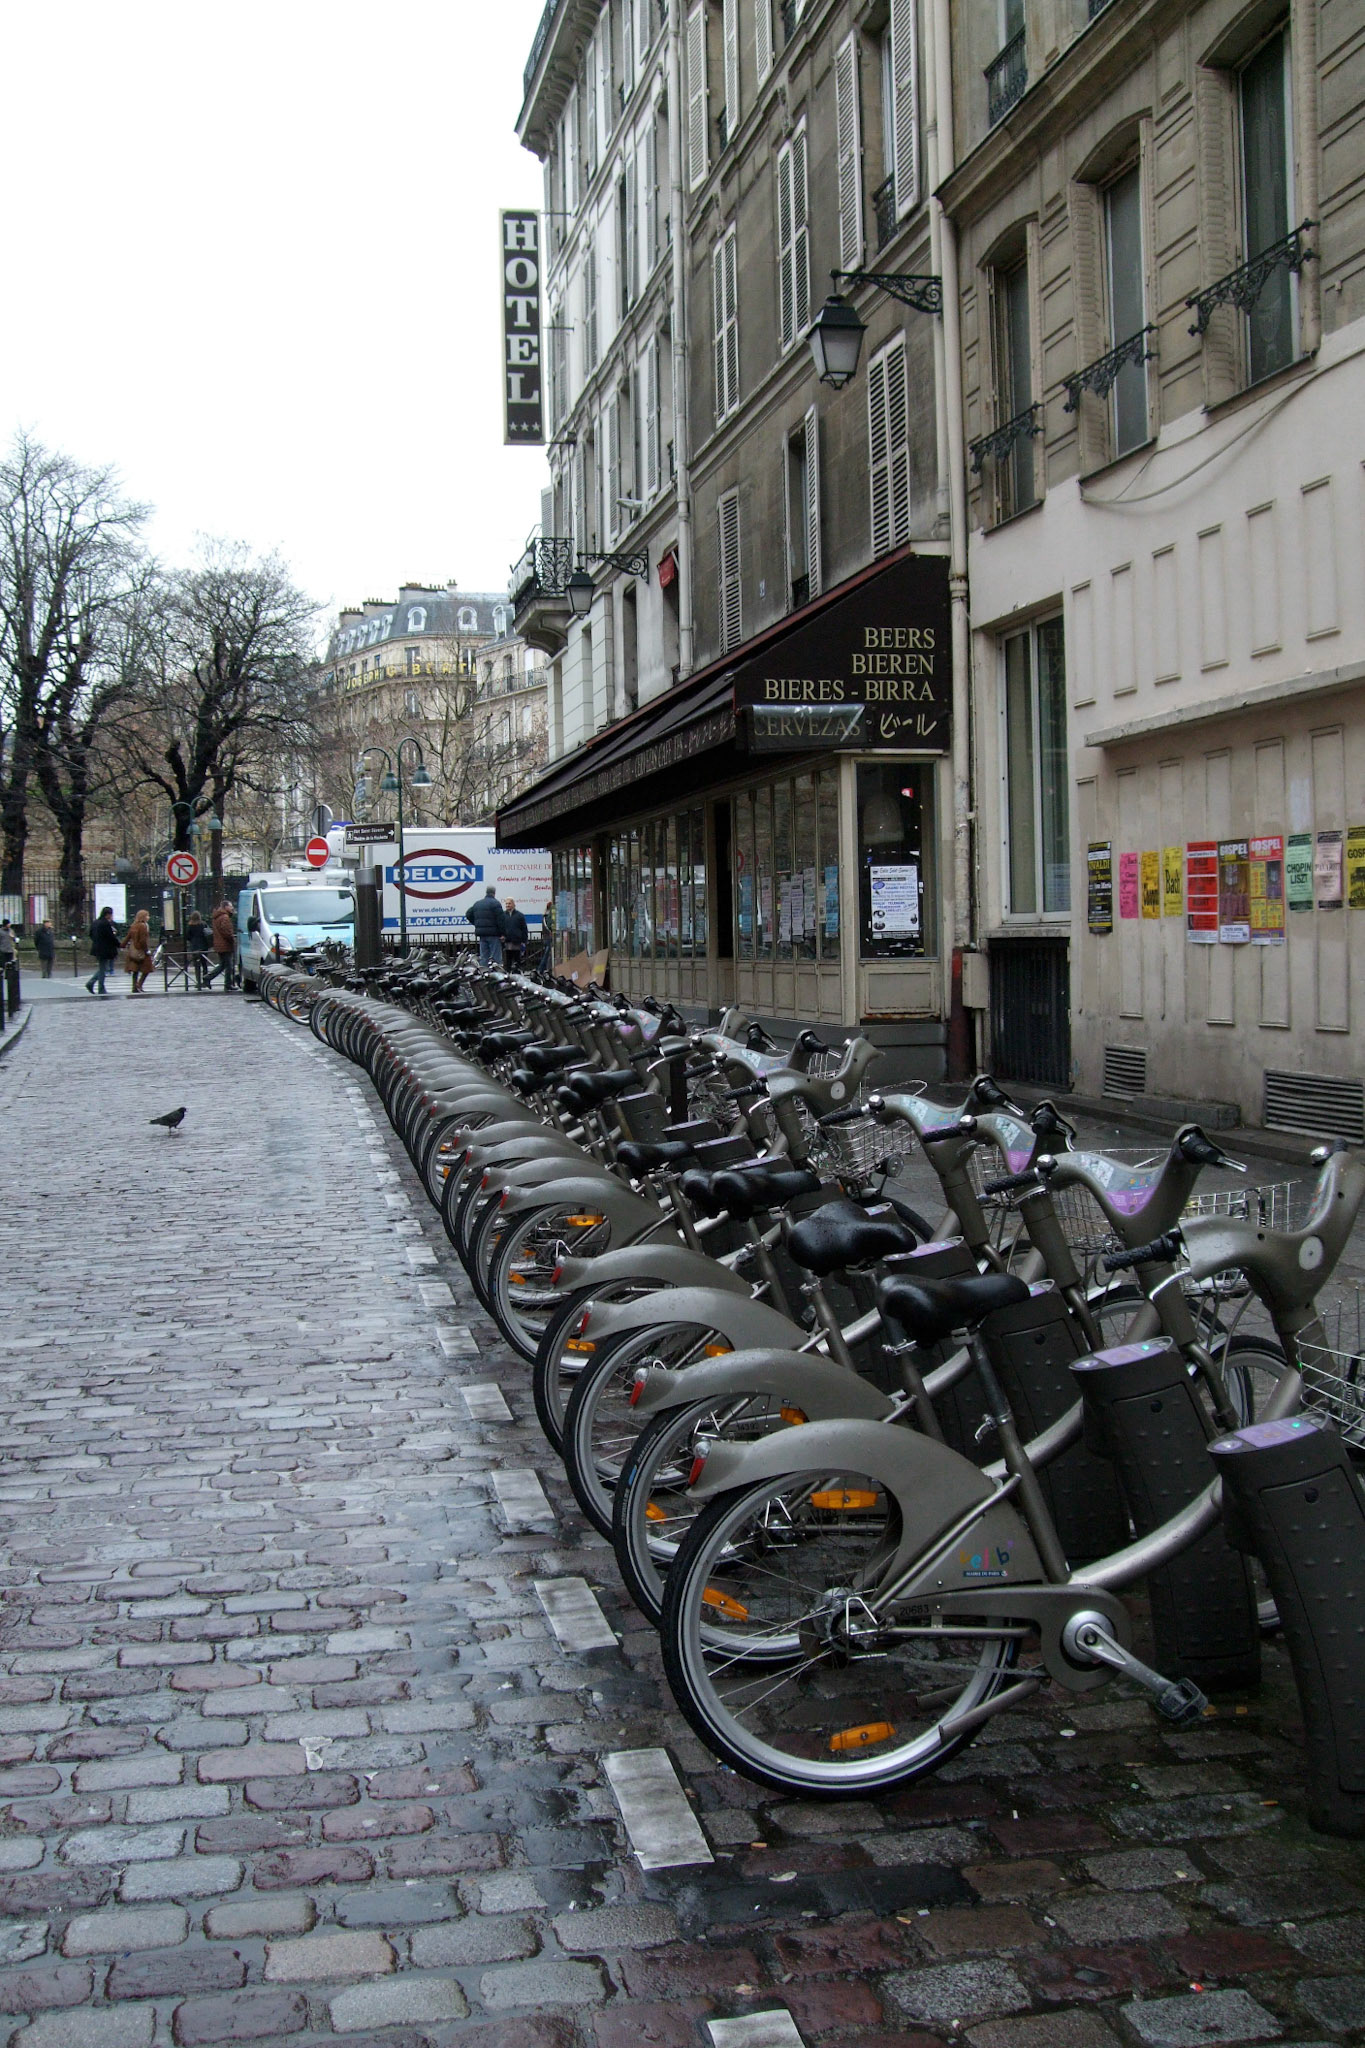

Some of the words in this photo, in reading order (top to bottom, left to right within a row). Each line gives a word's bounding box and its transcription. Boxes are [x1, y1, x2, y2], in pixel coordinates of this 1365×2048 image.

[504, 219, 540, 404] HOTEL
[864, 627, 936, 649] BEERS
[852, 654, 935, 675] BIEREN
[764, 679, 845, 701] BIERES
[864, 680, 936, 701] BIRRA
[754, 715, 861, 736] CERVEZAS
[881, 713, 937, 738] ビール
[1220, 843, 1248, 856] GOSPEL
[1251, 838, 1282, 851] GOSPEL
[393, 867, 476, 881] DELON
[500, 863, 541, 871] PARTENAIRE
[1286, 862, 1312, 873] CHOPIN
[1165, 868, 1181, 894] Bach
[1290, 873, 1308, 884] LISZT
[412, 906, 456, 914] www.delon.fr
